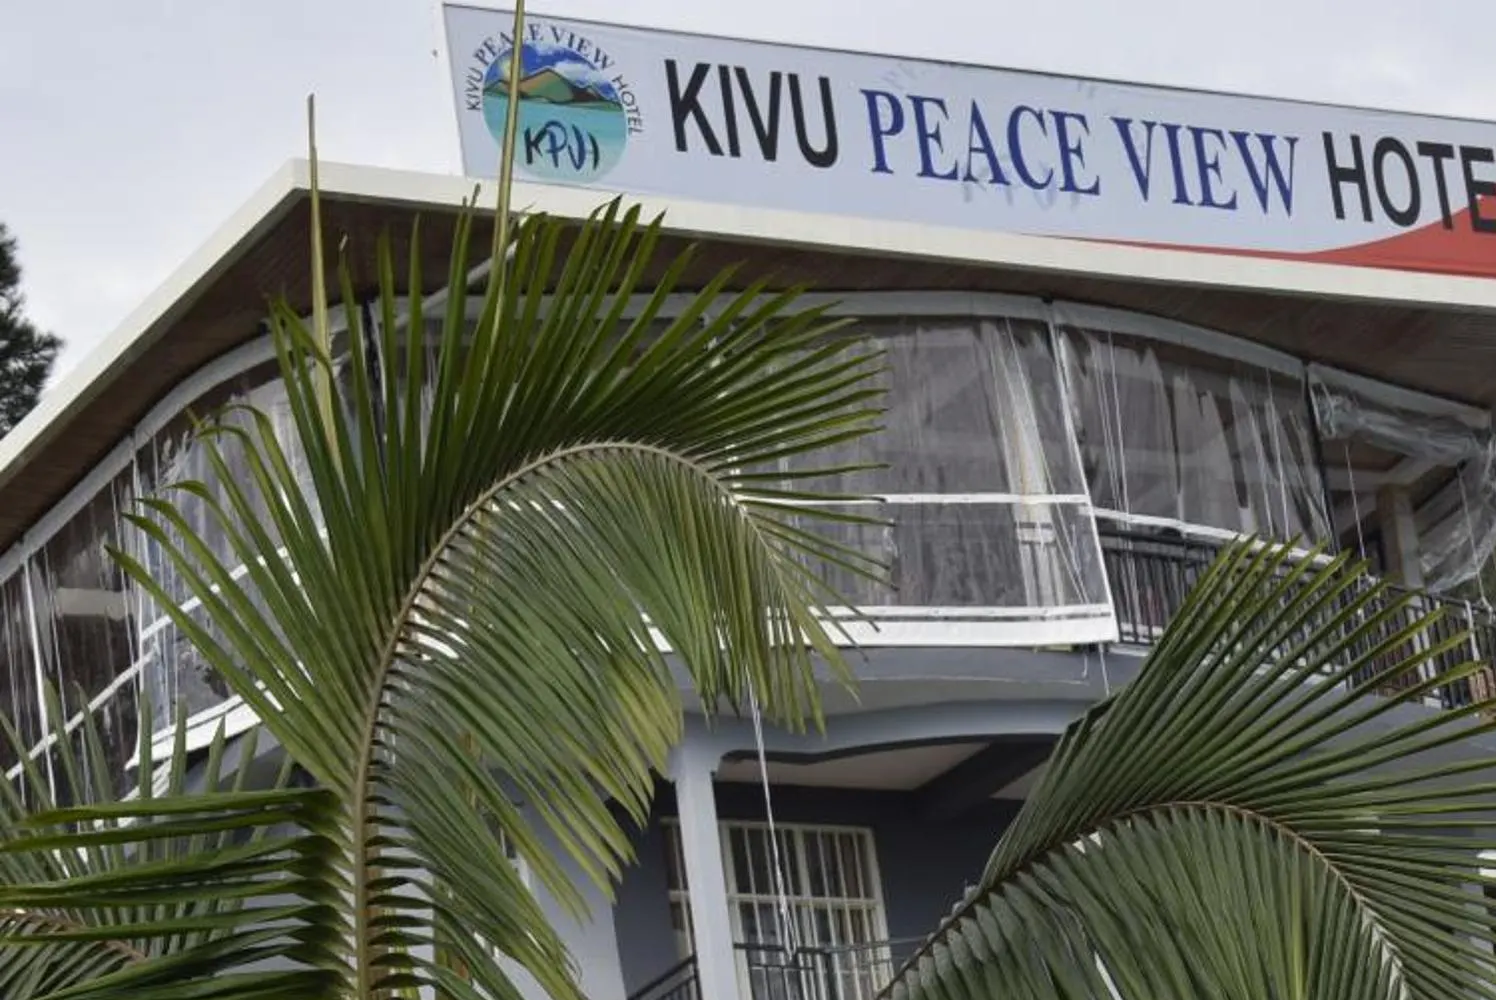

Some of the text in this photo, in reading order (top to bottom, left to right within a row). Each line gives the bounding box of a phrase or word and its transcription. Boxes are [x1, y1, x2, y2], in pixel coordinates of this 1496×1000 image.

[465, 23, 644, 135] KIVU PEAE VIEW HOTEL
[664, 59, 838, 168] KIVU
[860, 88, 1100, 196] PEACE
[1111, 116, 1299, 217] VIEW
